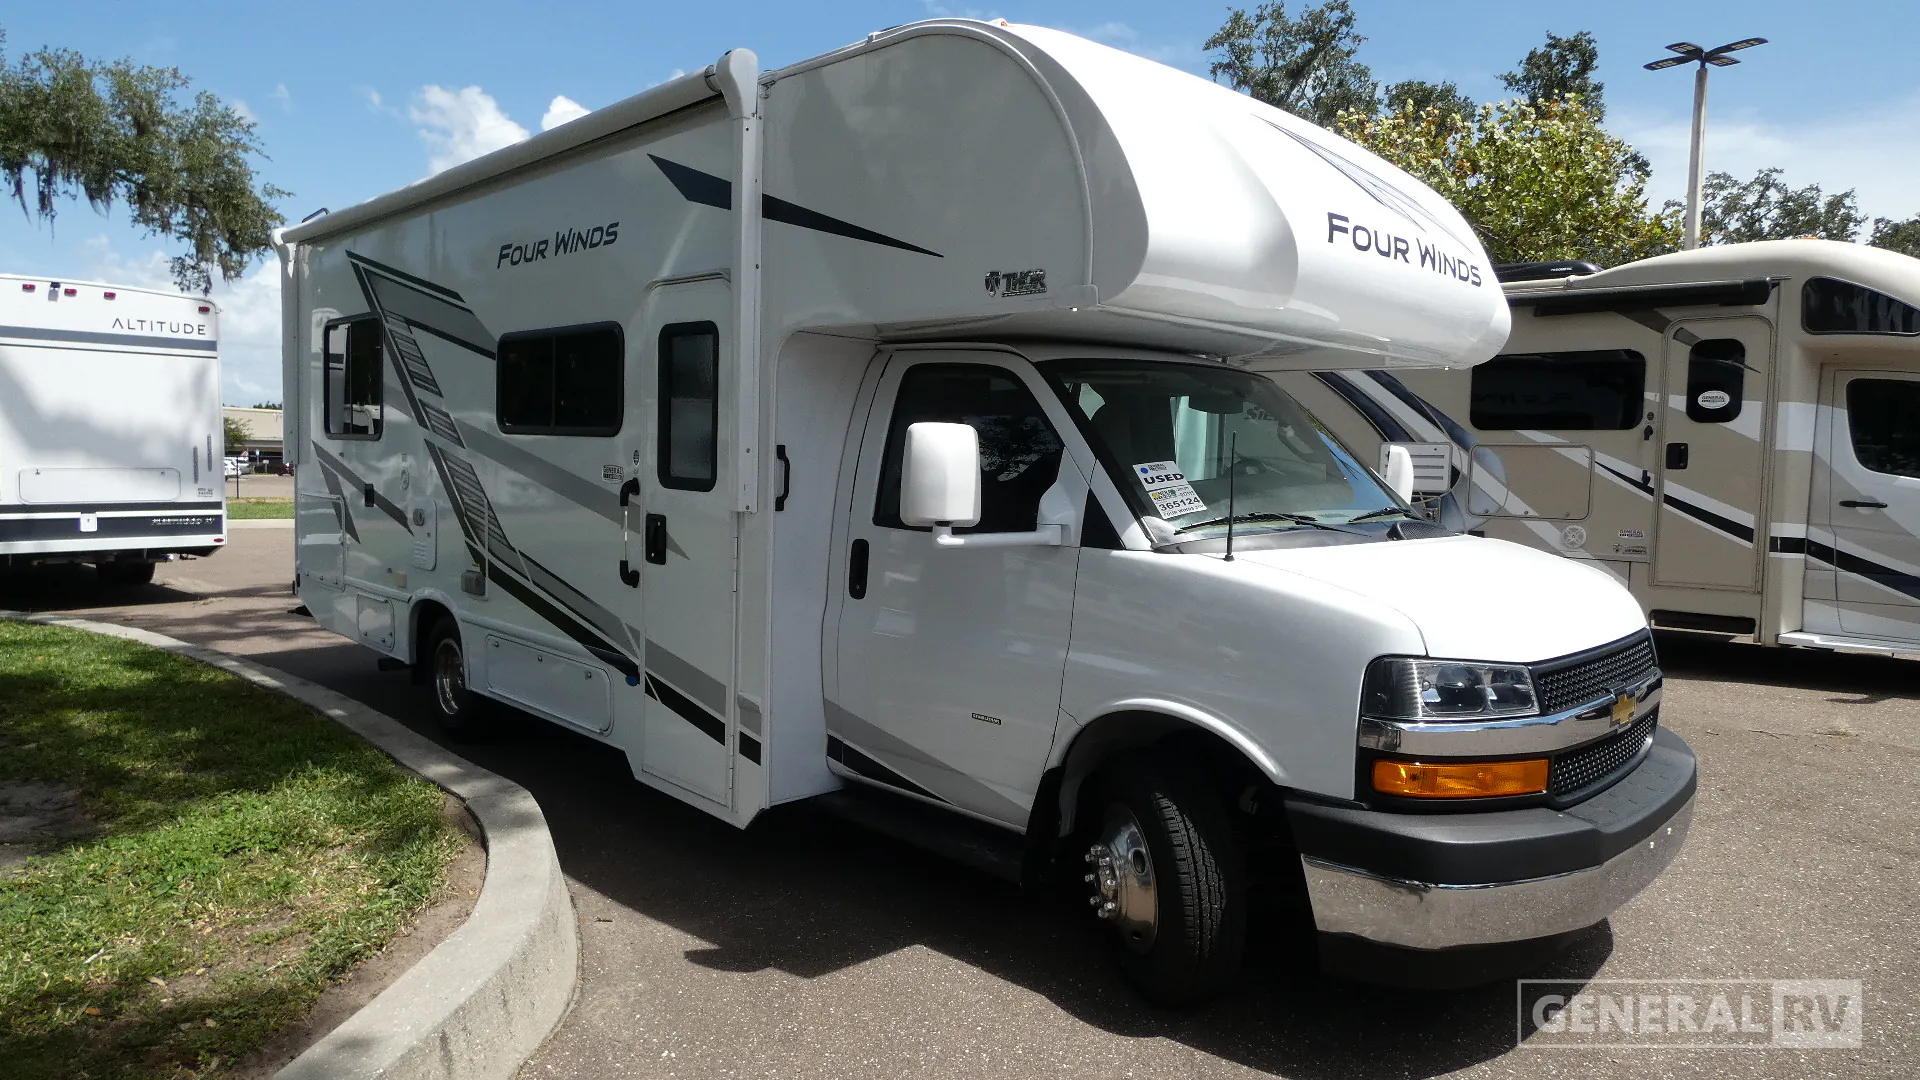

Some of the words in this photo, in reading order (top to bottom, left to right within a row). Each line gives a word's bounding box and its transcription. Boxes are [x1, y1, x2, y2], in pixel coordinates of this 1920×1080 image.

[496, 243, 549, 269] FOUR
[554, 222, 620, 256] WINDS
[1327, 212, 1410, 264] FOUR
[1416, 237, 1482, 287] WINDS
[112, 317, 207, 336] ALTITUDE
[1143, 473, 1185, 484] USED
[1158, 497, 1200, 511] 365124
